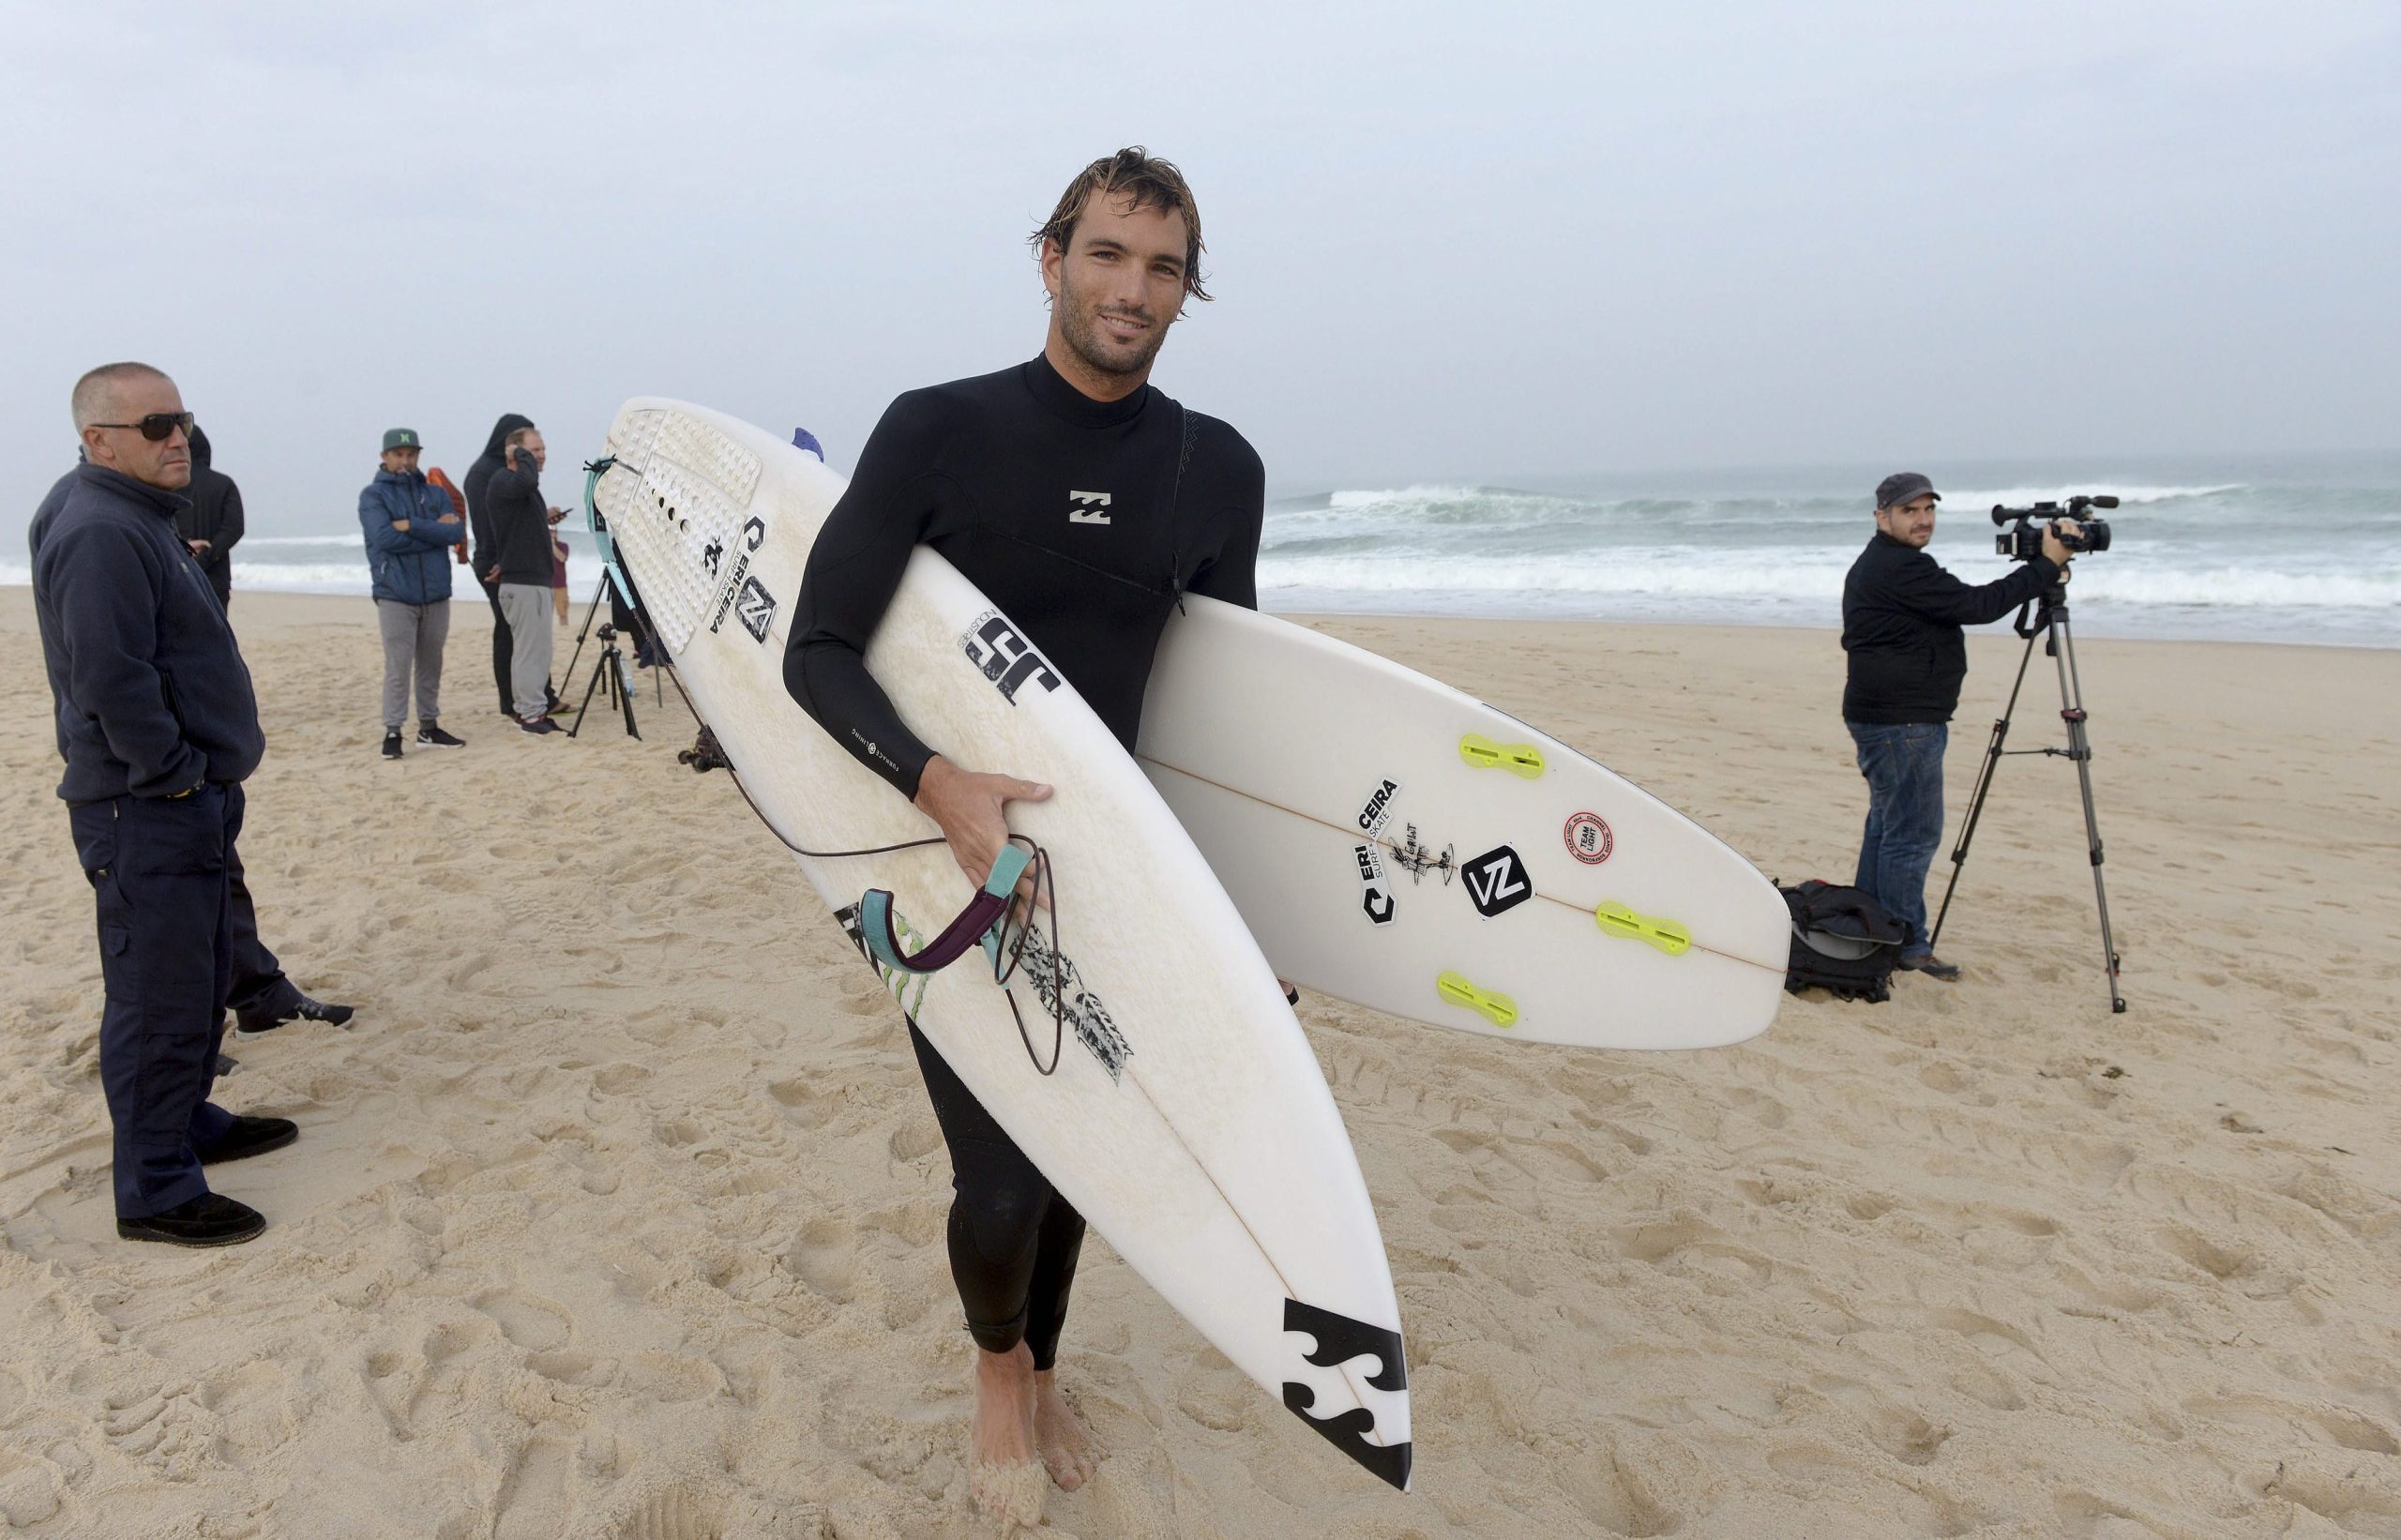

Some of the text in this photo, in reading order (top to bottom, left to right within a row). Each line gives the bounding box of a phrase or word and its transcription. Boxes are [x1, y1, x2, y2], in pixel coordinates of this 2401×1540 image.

[709, 553, 750, 635] ERI CEIRA
[851, 728, 899, 772] FURNACE LINING
[1354, 778, 1398, 881] ERI CEIRA
[1369, 810, 1390, 878] SURF SKATE
[1580, 826, 1590, 848] TEAM
[1587, 827, 1596, 852] LIGHT
